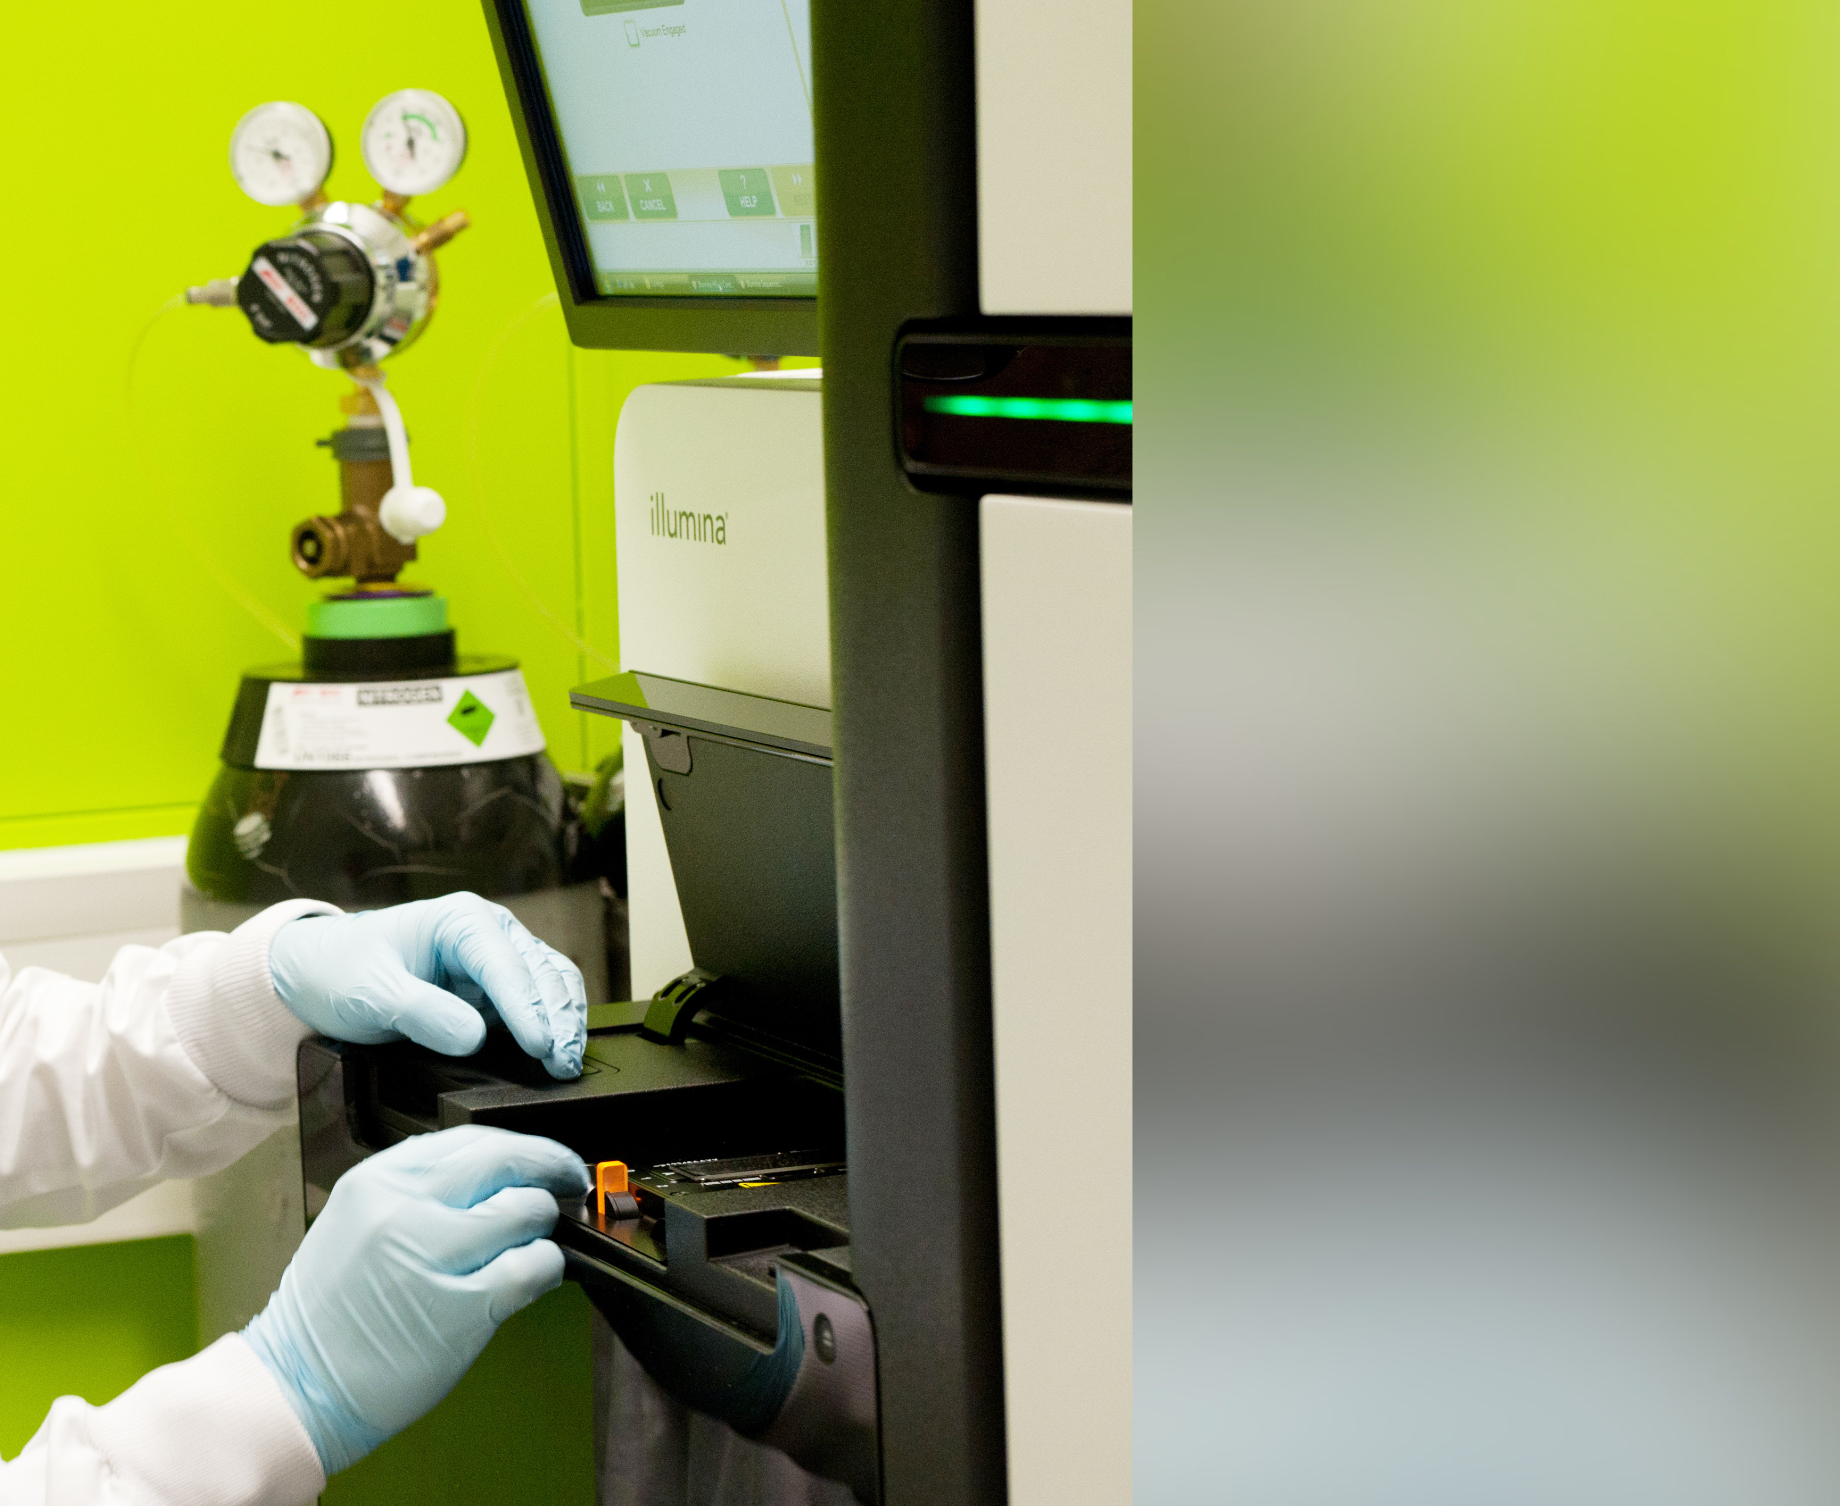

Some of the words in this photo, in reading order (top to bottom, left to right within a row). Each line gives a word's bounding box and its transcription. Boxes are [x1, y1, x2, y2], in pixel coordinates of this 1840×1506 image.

[639, 26, 661, 38] Vacuum
[661, 22, 687, 37] Engaged
[597, 200, 615, 212] BACK
[640, 199, 666, 212] CANCEL
[739, 195, 758, 208] HELP
[650, 491, 727, 545] illumina
[358, 686, 442, 706] NITROGEN
